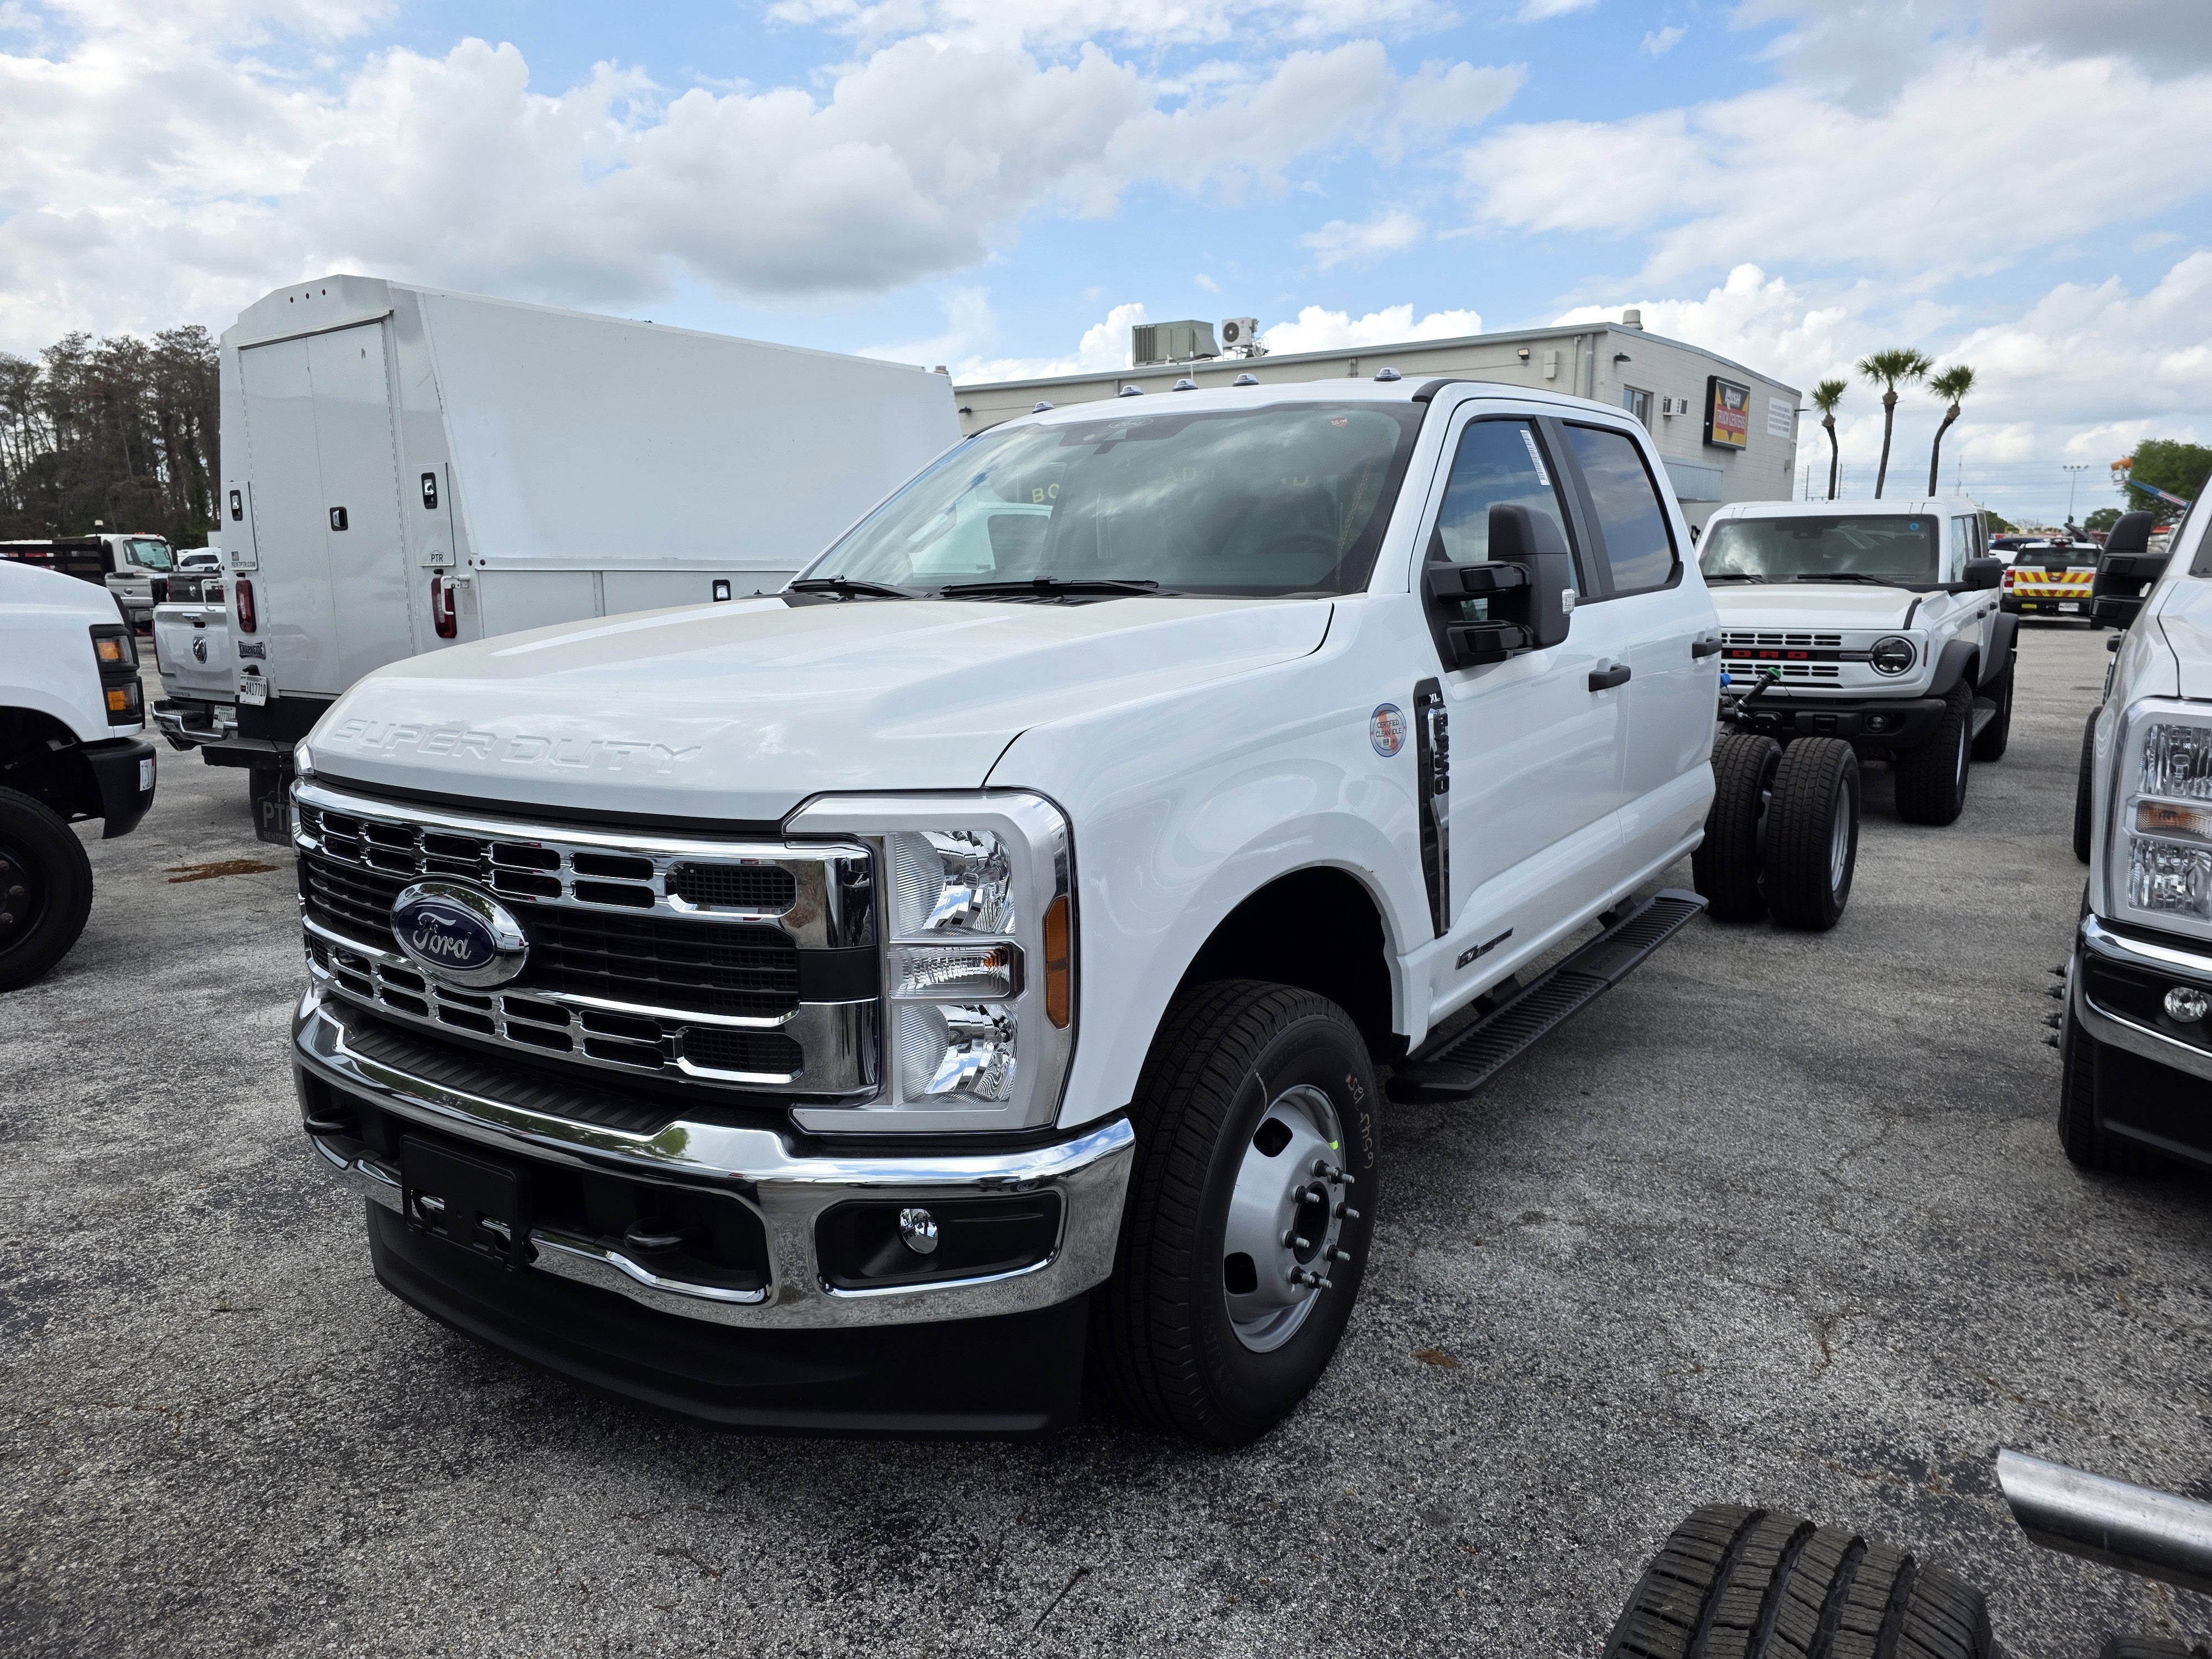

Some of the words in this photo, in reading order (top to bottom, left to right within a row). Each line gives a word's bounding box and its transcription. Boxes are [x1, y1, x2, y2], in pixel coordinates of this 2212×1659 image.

[1725, 387, 1741, 410] RUSH
[1717, 409, 1729, 425] TRUCK
[1729, 411, 1745, 430] CENTERS
[431, 554, 444, 563] PTR
[1721, 649, 1808, 659] ORD
[246, 682, 266, 697] 3417710
[1428, 692, 1441, 704] XL
[1377, 719, 1399, 728] CERTIFIED
[332, 718, 499, 760] SUPER
[501, 734, 703, 774] DUTY
[413, 912, 472, 960] Ford
